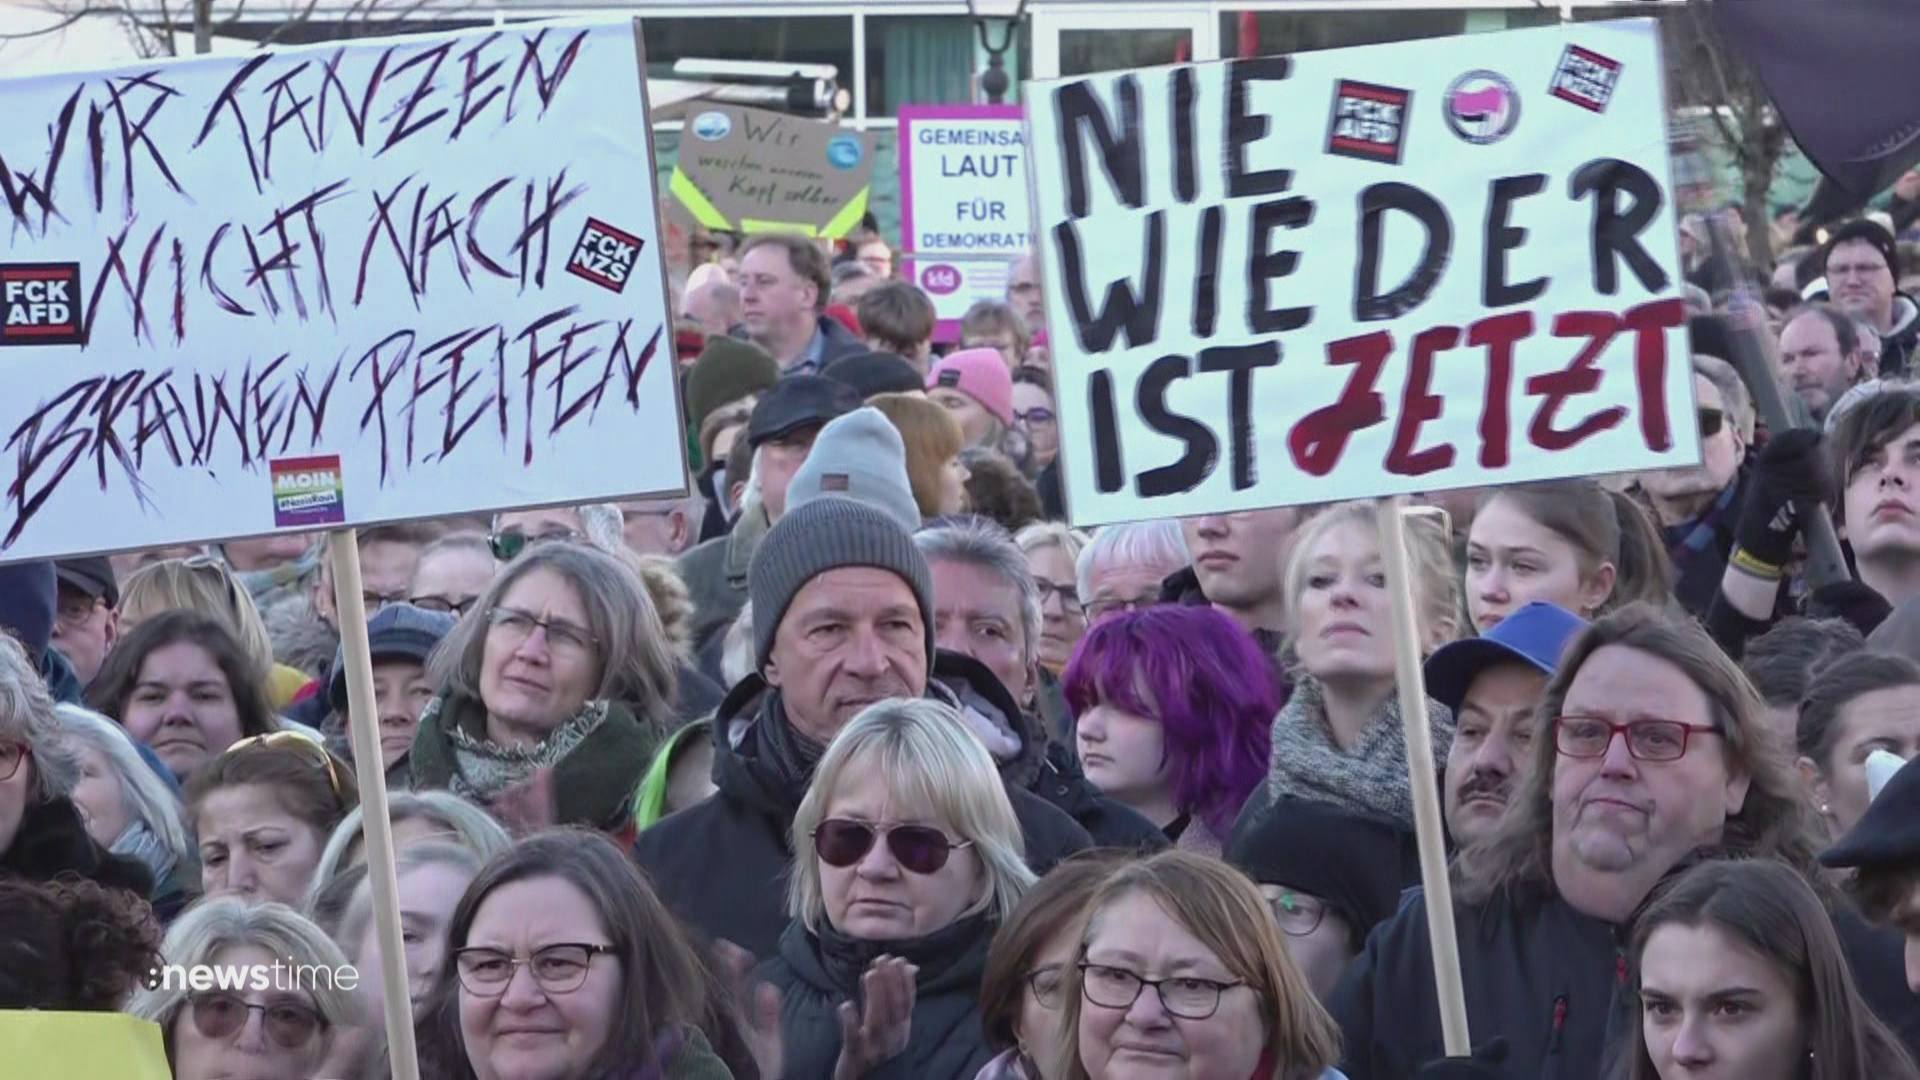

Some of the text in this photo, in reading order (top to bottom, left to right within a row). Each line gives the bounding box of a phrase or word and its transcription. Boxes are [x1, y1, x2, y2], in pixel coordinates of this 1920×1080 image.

[1337, 97, 1402, 124] FCK
[0, 28, 590, 247] WIR TANZEN
[743, 113, 801, 147] Wir
[919, 129, 1025, 146] GEMEINSA
[1053, 56, 1294, 218] NIE
[1333, 118, 1399, 143] AFD
[942, 155, 1018, 178] LAUT
[728, 174, 777, 205] Kopf
[957, 198, 1006, 221] FÜR
[582, 227, 636, 265] FCK
[922, 232, 1038, 248] DEMOKRATI
[1052, 157, 1670, 353] WIEDER
[82, 166, 590, 350] NICHT NACH
[573, 246, 628, 283] NZS
[6, 280, 70, 303] FCK
[6, 303, 70, 325] AFD
[1087, 298, 1685, 498] IST JETZT
[4, 304, 663, 550] BRAUNEN PFEIFEN
[277, 471, 336, 489] MOIN
